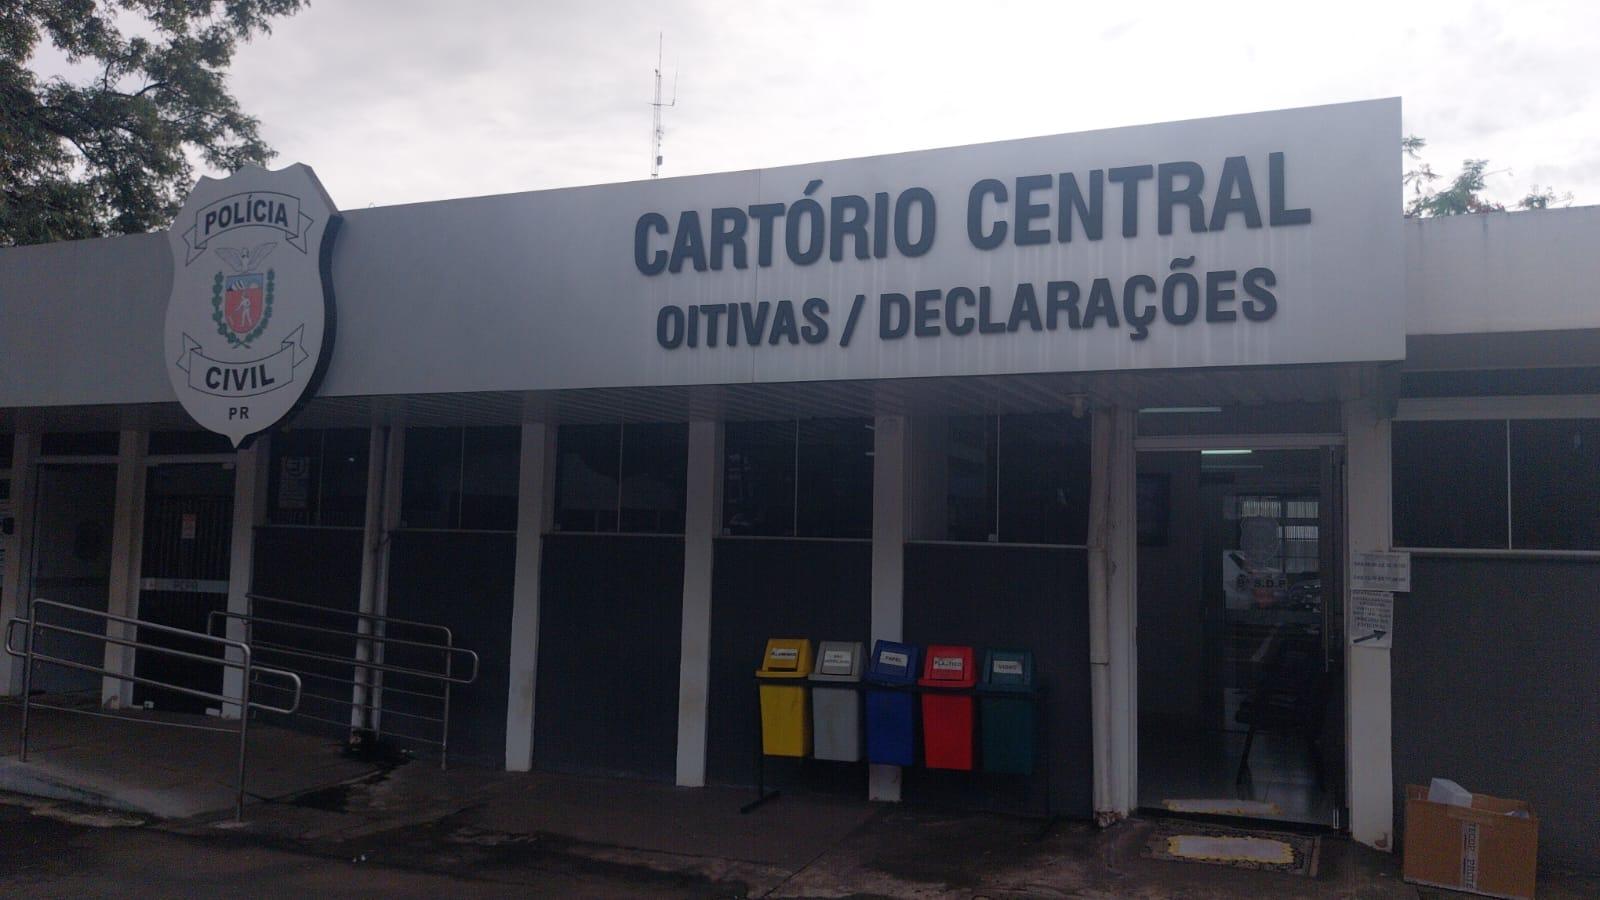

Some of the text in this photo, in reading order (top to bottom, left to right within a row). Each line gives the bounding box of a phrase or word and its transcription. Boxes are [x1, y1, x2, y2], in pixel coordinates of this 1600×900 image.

[205, 195, 288, 235] POLÍCIA
[634, 151, 1311, 276] CARTÓRIO CENTRAL
[656, 255, 1278, 349] OITIVAS / DECLARAÇÕES
[205, 364, 275, 391] CIVIL
[228, 407, 249, 420] PR
